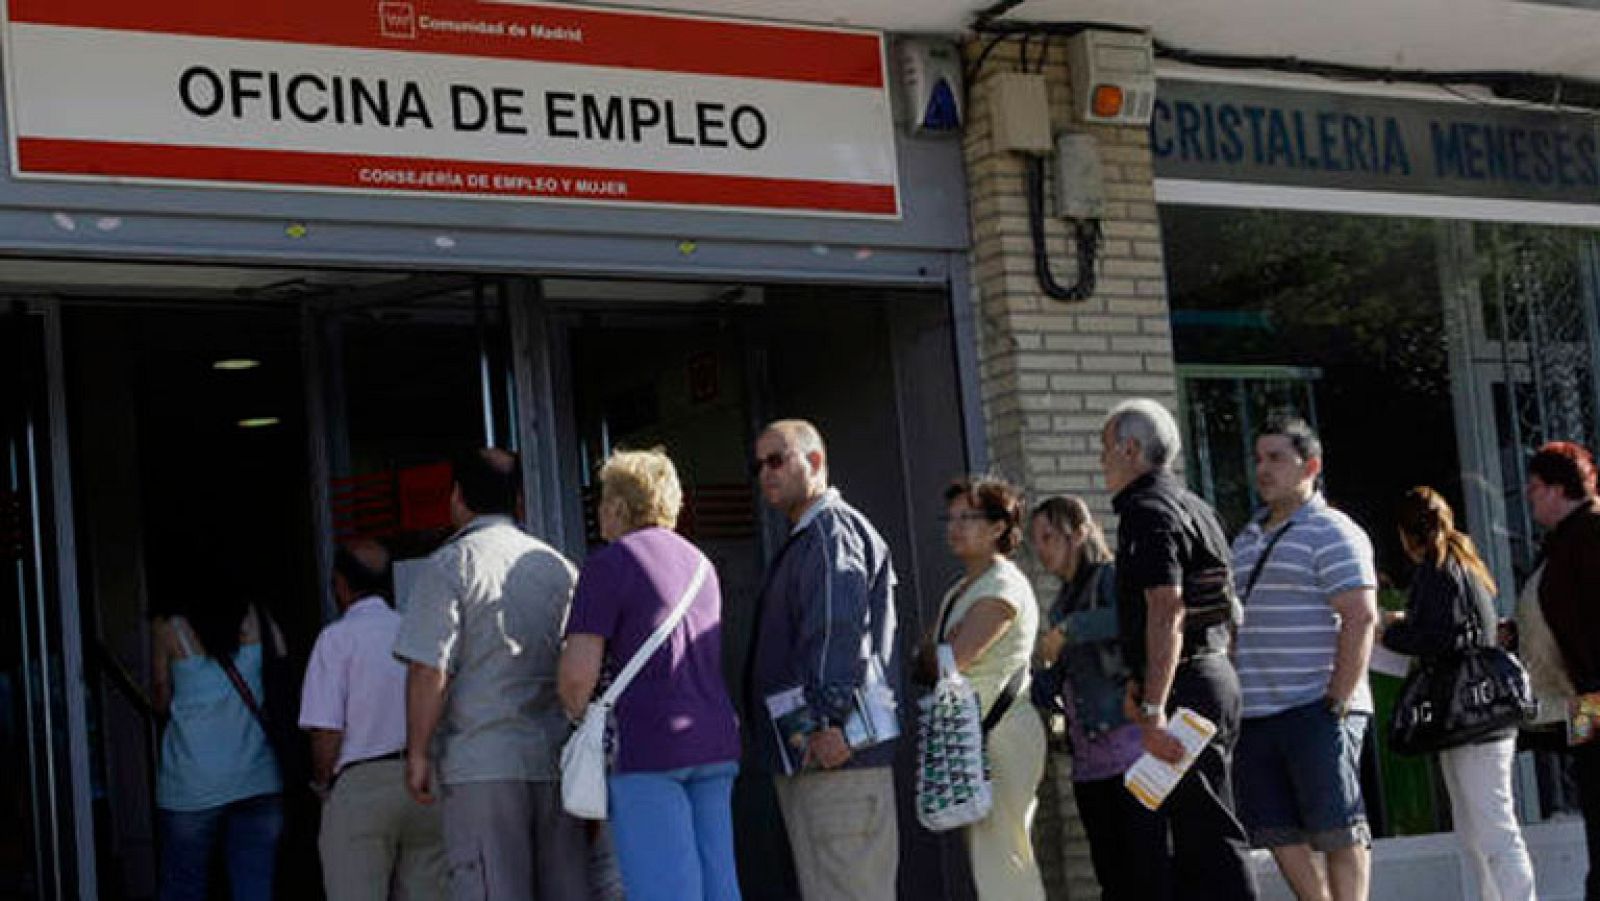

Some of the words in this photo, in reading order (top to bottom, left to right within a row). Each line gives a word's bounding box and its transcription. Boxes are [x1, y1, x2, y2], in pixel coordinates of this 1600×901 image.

[419, 16, 504, 34] Comunidad
[508, 24, 526, 37] de
[531, 24, 582, 41] Madrid
[179, 66, 433, 128] OFICINA
[451, 85, 527, 134] DE
[545, 91, 766, 150] EMPLEO
[1151, 99, 1410, 175] CRISTALERIA
[1432, 122, 1599, 187] MENESES
[467, 174, 489, 188] DE
[494, 175, 557, 192] EMPLEO
[560, 178, 571, 192] Y
[576, 179, 628, 194] MUJER
